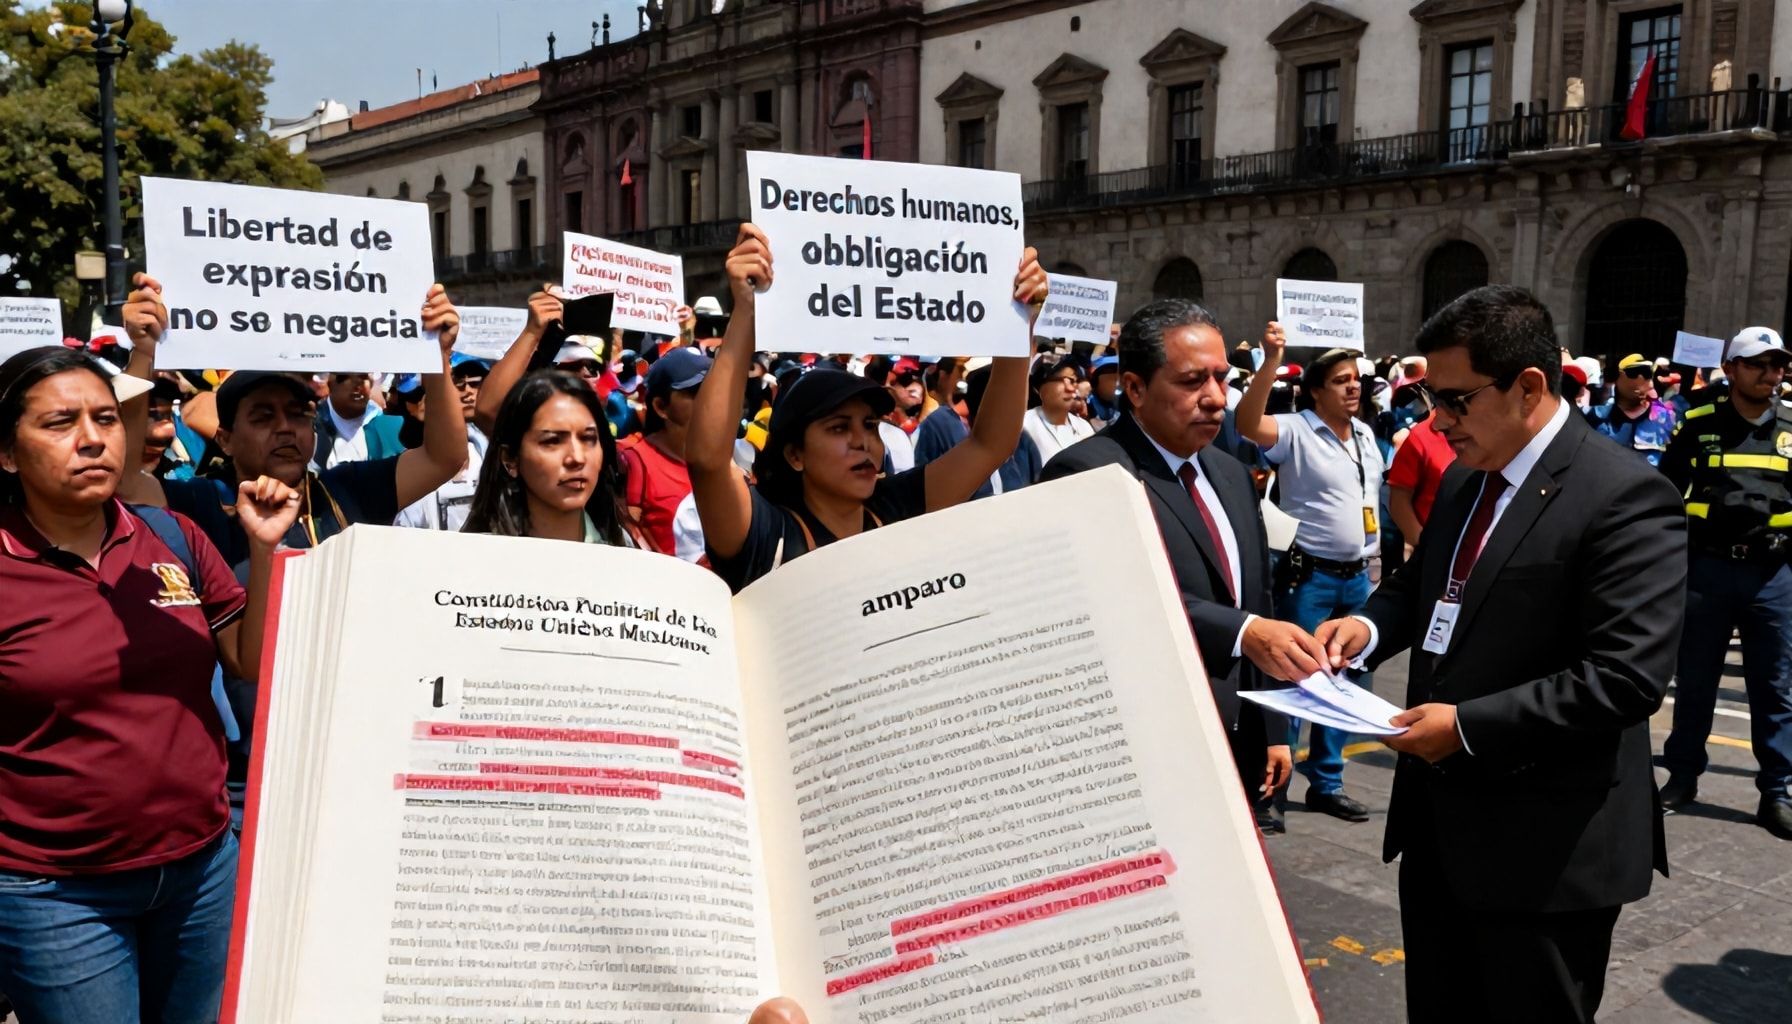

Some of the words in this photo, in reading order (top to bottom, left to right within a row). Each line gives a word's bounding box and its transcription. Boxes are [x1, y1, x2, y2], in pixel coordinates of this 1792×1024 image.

[760, 178, 896, 218] Derechos
[901, 186, 1019, 231] humanos,
[182, 206, 339, 247] Libertad
[350, 220, 393, 251] de
[801, 233, 988, 279] obbligación
[202, 260, 387, 298] exprasión
[170, 308, 218, 331] no
[283, 309, 418, 344] negacia
[807, 283, 864, 318] del
[875, 286, 986, 324] Estado
[861, 569, 967, 617] amparo
